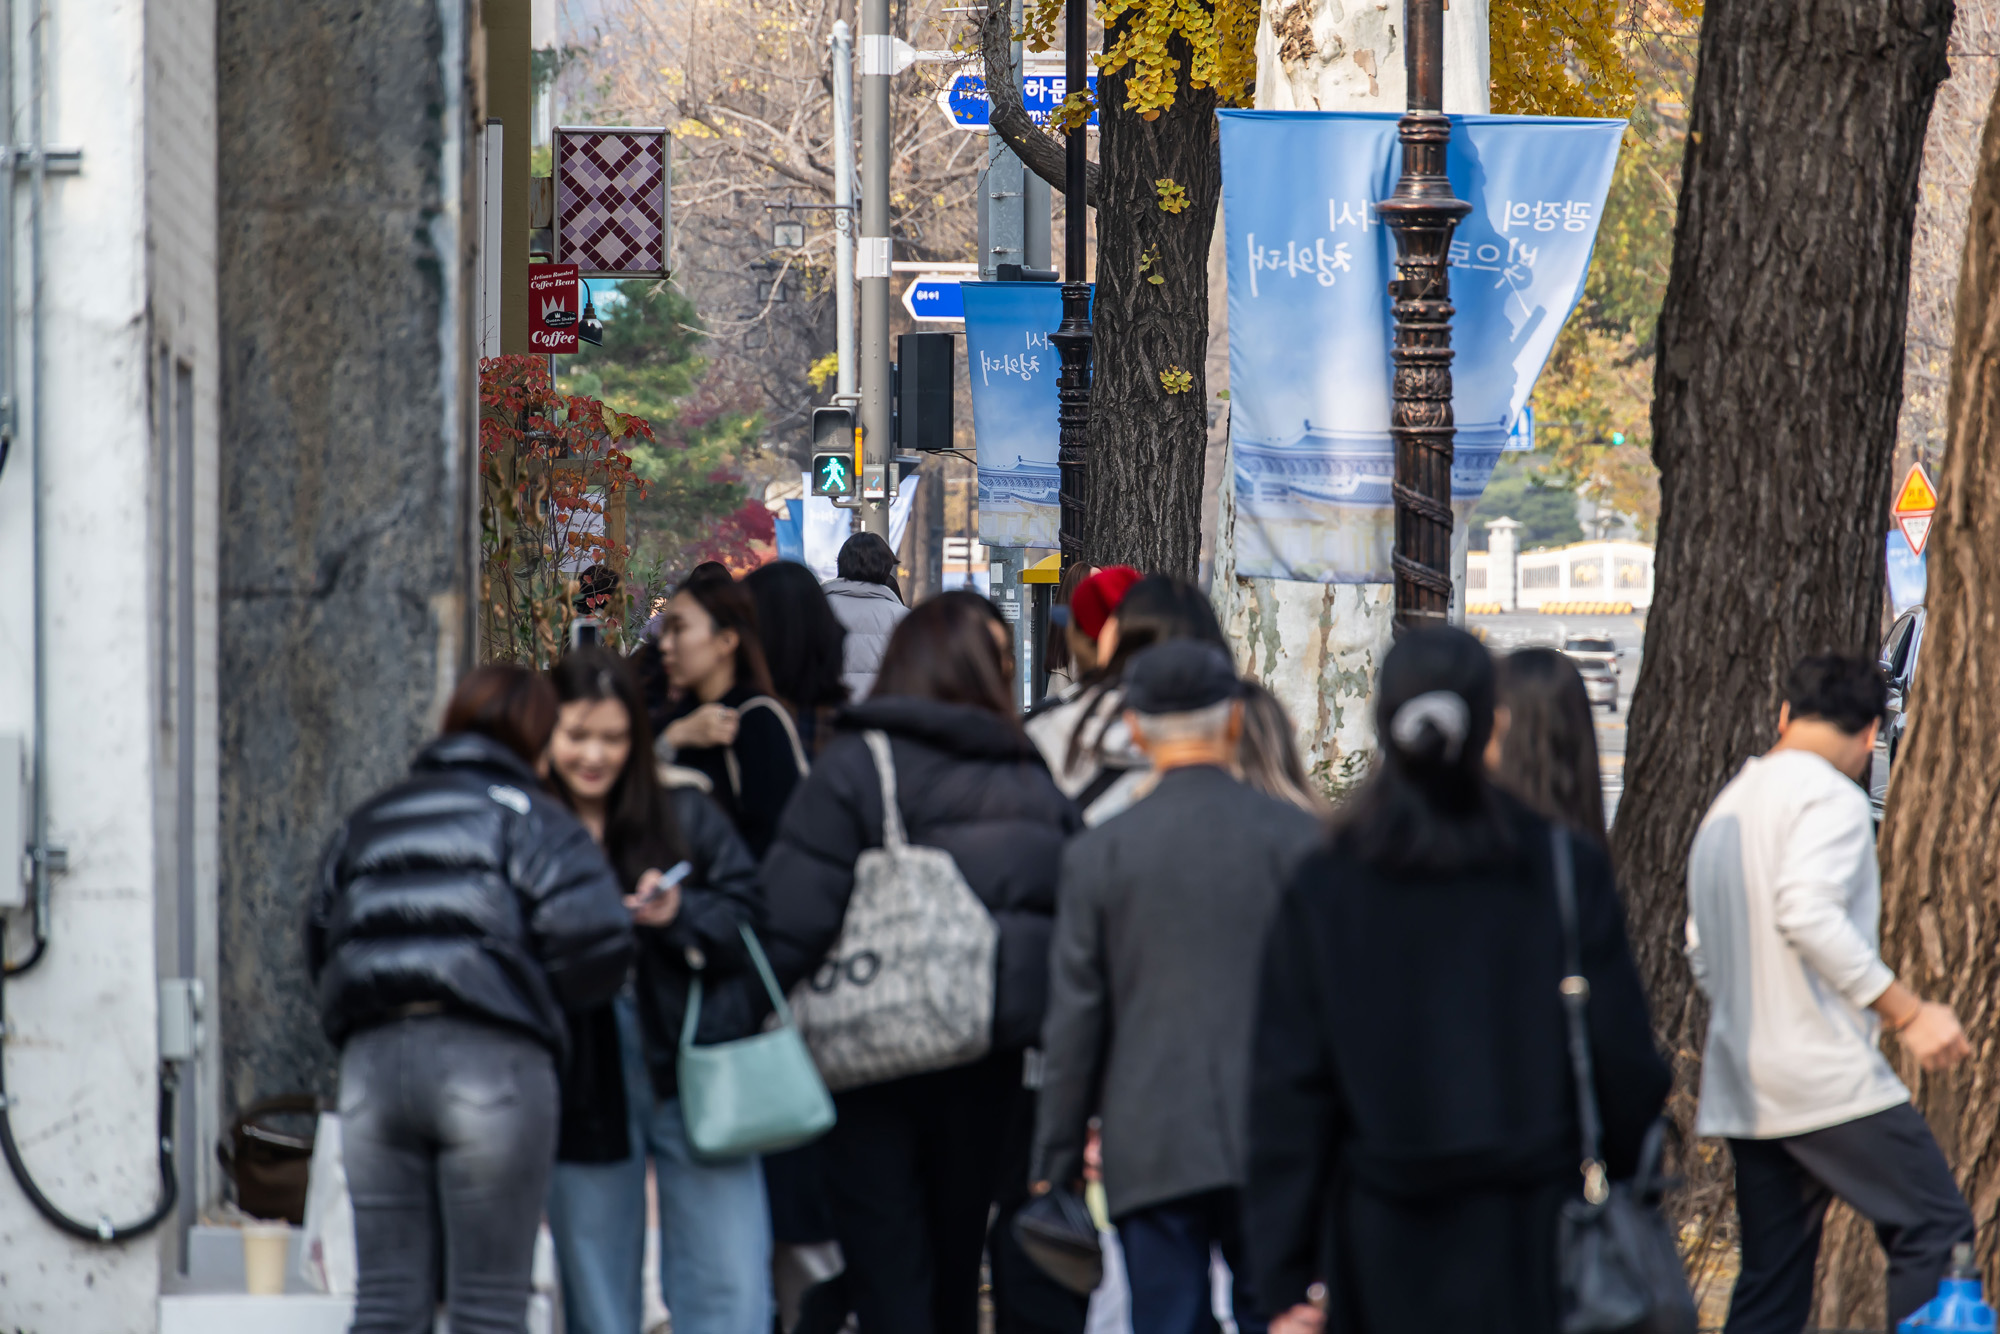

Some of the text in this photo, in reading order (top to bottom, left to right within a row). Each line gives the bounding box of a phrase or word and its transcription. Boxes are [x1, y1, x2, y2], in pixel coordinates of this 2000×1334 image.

[531, 279, 575, 290] Coffee Bean
[531, 330, 575, 347] Coffee
